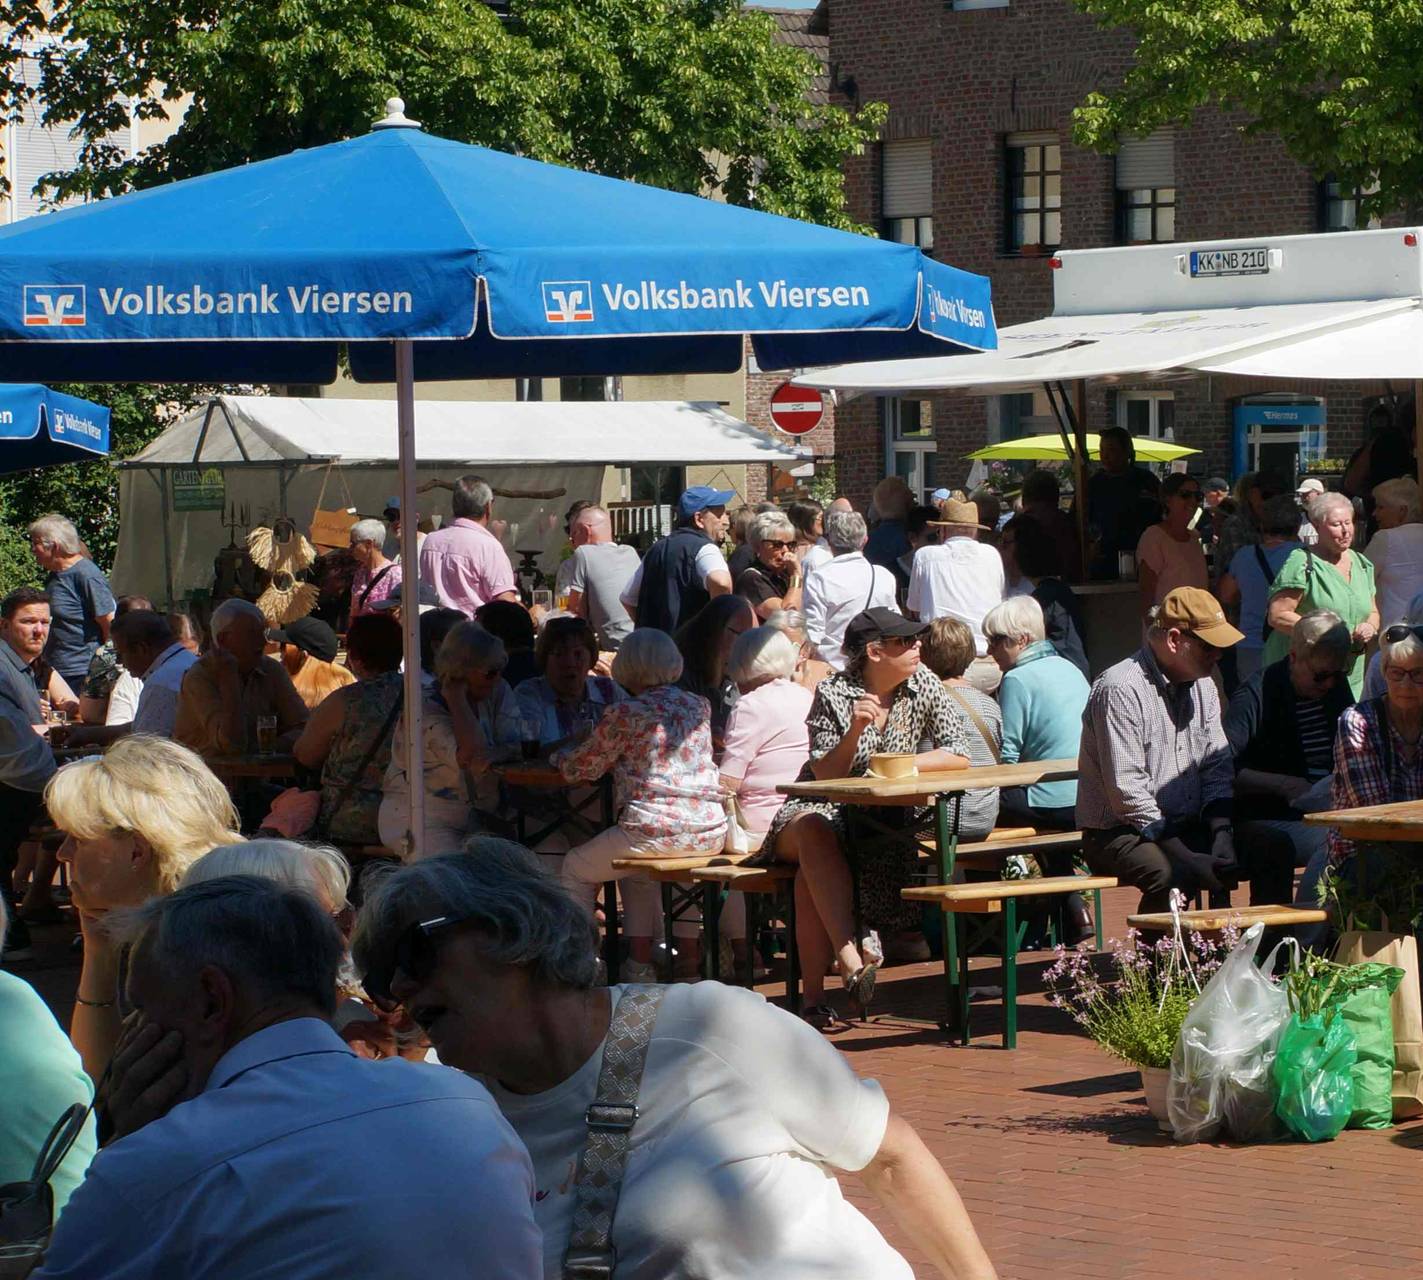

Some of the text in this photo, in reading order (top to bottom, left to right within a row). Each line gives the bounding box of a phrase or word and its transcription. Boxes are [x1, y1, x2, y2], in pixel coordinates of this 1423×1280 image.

[1198, 251, 1265, 270] KK NB 210
[98, 284, 412, 315] Volksbank Viersen
[601, 279, 870, 311] Volksbank Viersen
